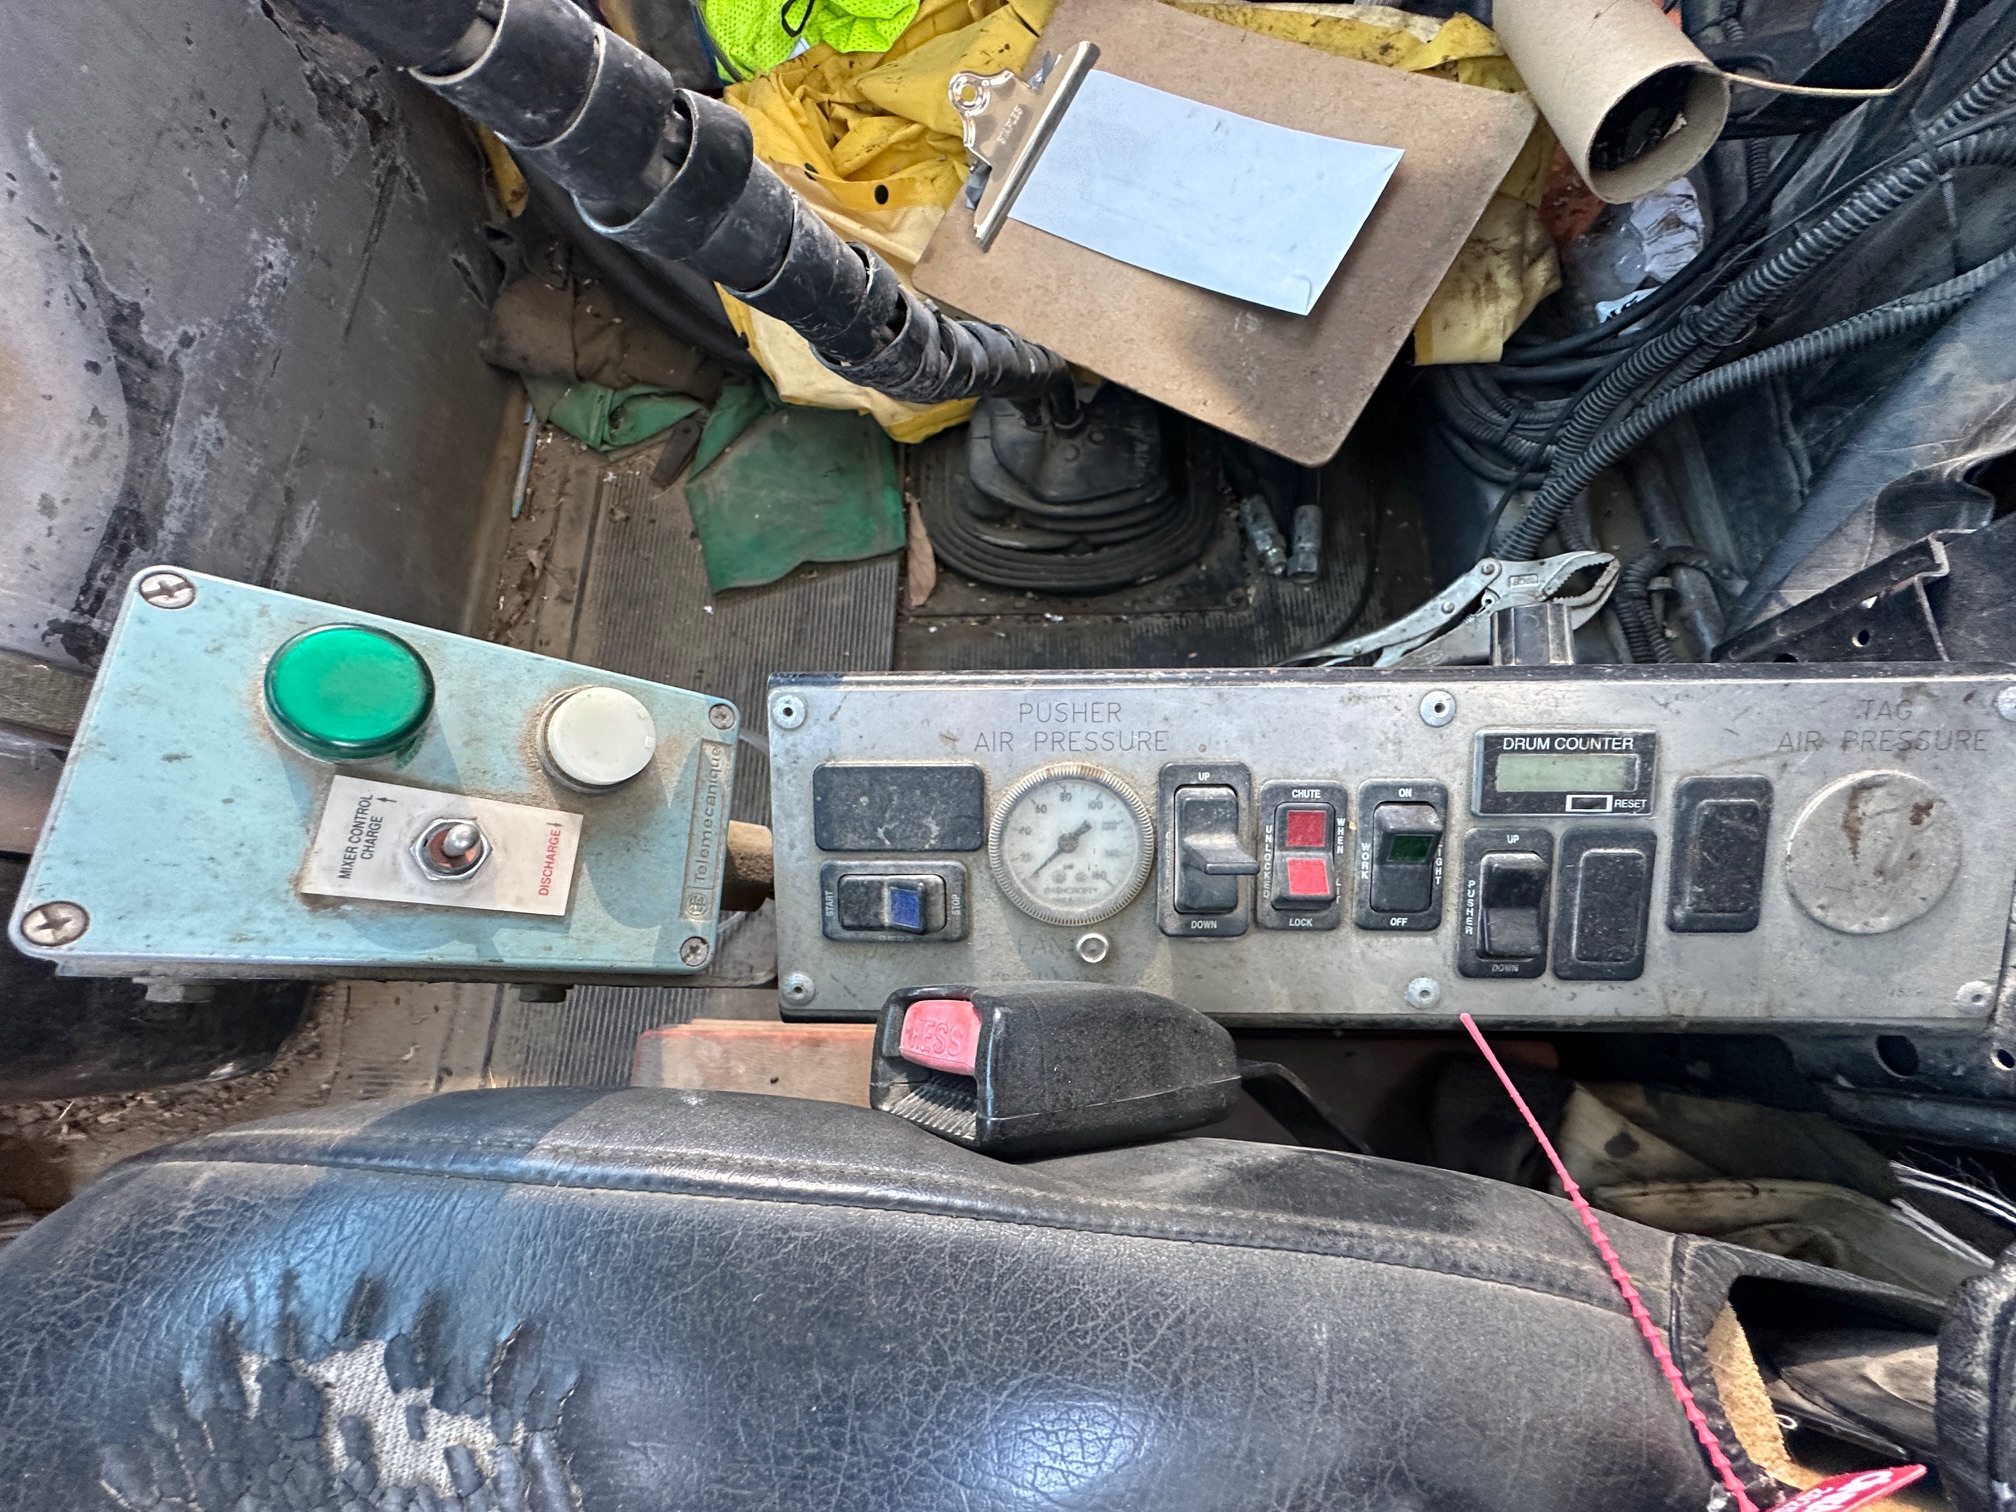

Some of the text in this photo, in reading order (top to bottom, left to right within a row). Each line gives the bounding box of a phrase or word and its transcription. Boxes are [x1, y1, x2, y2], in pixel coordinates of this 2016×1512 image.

[1019, 702, 1121, 723] PUSHER
[1861, 699, 1913, 720] TAG
[974, 730, 1169, 752] AIR PRESSURE
[1502, 738, 1634, 750] DRUM COUNTER
[1778, 729, 1990, 752] AIR PRESSURE
[1198, 772, 1211, 781] UP
[1292, 789, 1321, 799] CHUTE
[1399, 788, 1412, 797] ON
[1035, 804, 1047, 814] 60
[1614, 799, 1647, 808] RESET
[694, 746, 722, 883] Telemecanique
[339, 794, 374, 880] MIXER CONTROL
[361, 816, 383, 860] CHARGE
[1337, 818, 1346, 854] WHEN
[1507, 835, 1520, 844] UP
[538, 829, 561, 896] DISCHARGE
[1264, 825, 1273, 898] UNLOCKED
[1361, 843, 1371, 879] WORK
[825, 891, 834, 917] START
[951, 894, 961, 916] STOP
[1465, 880, 1476, 935] PUSHER
[1191, 920, 1217, 929] DOWN
[1289, 919, 1313, 927] LOCK
[1390, 917, 1408, 926] OFF
[1492, 964, 1519, 972] DOWN
